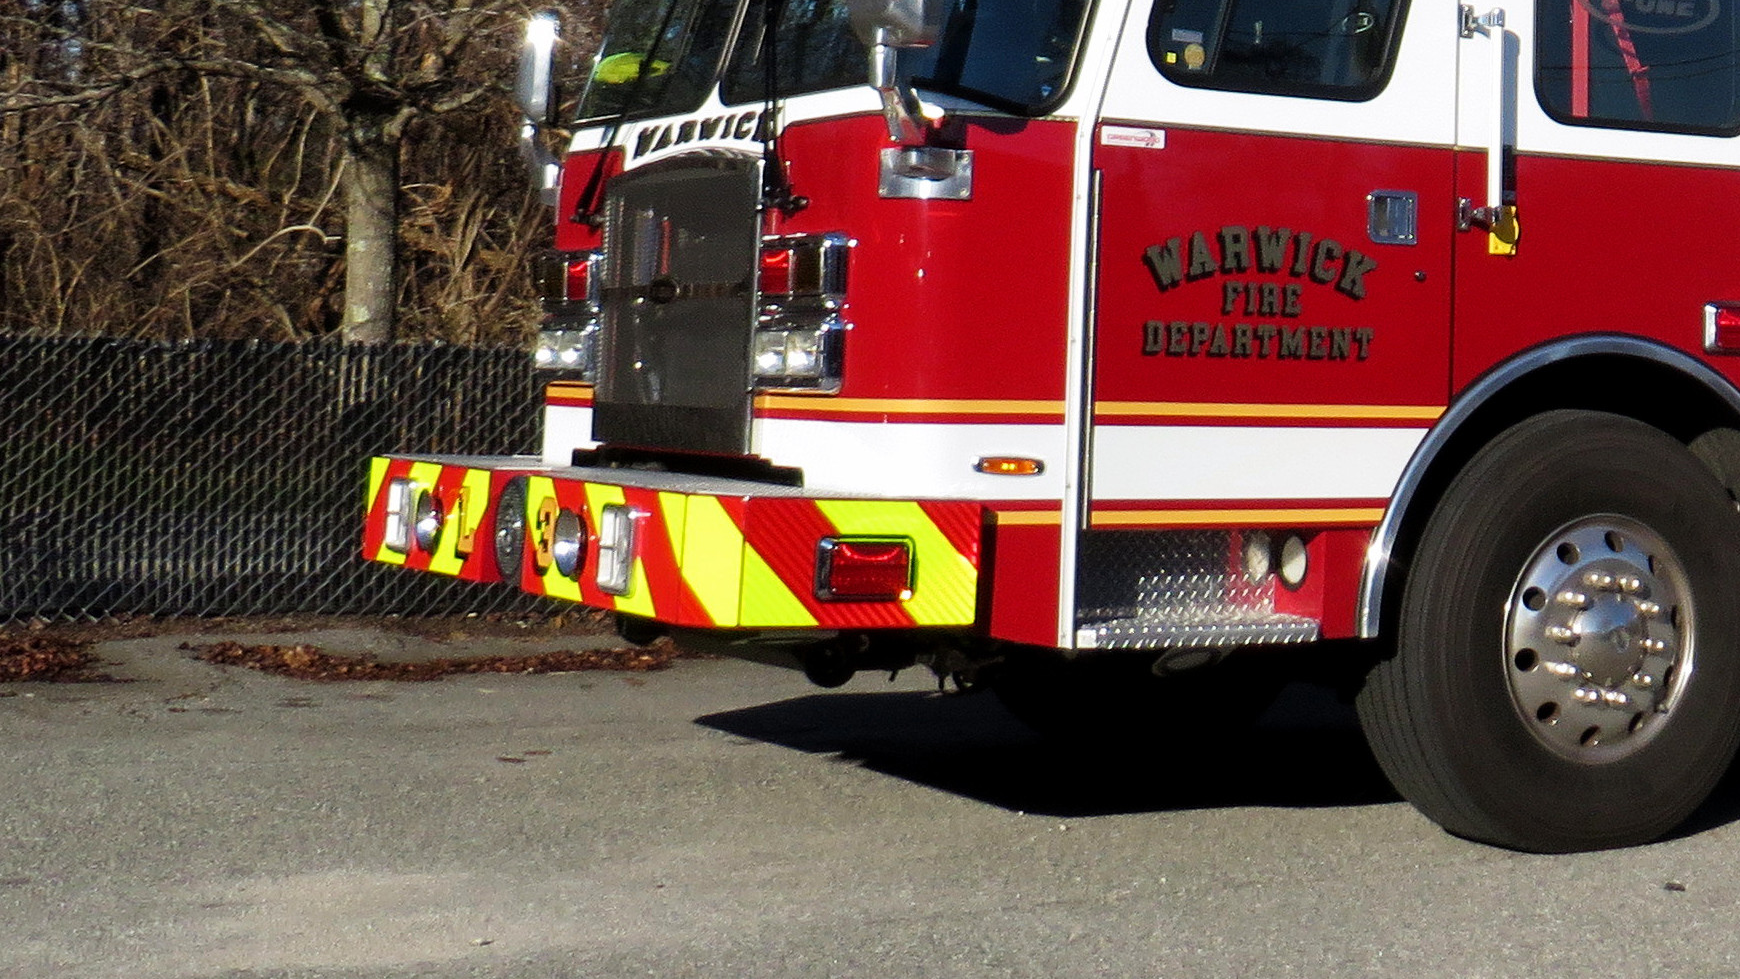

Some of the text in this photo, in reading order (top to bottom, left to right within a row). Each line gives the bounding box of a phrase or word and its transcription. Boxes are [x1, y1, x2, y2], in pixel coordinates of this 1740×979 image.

[1142, 225, 1379, 302] WARWICK
[1222, 281, 1302, 319] FIRE
[1141, 320, 1375, 362] DEPARTMENT
